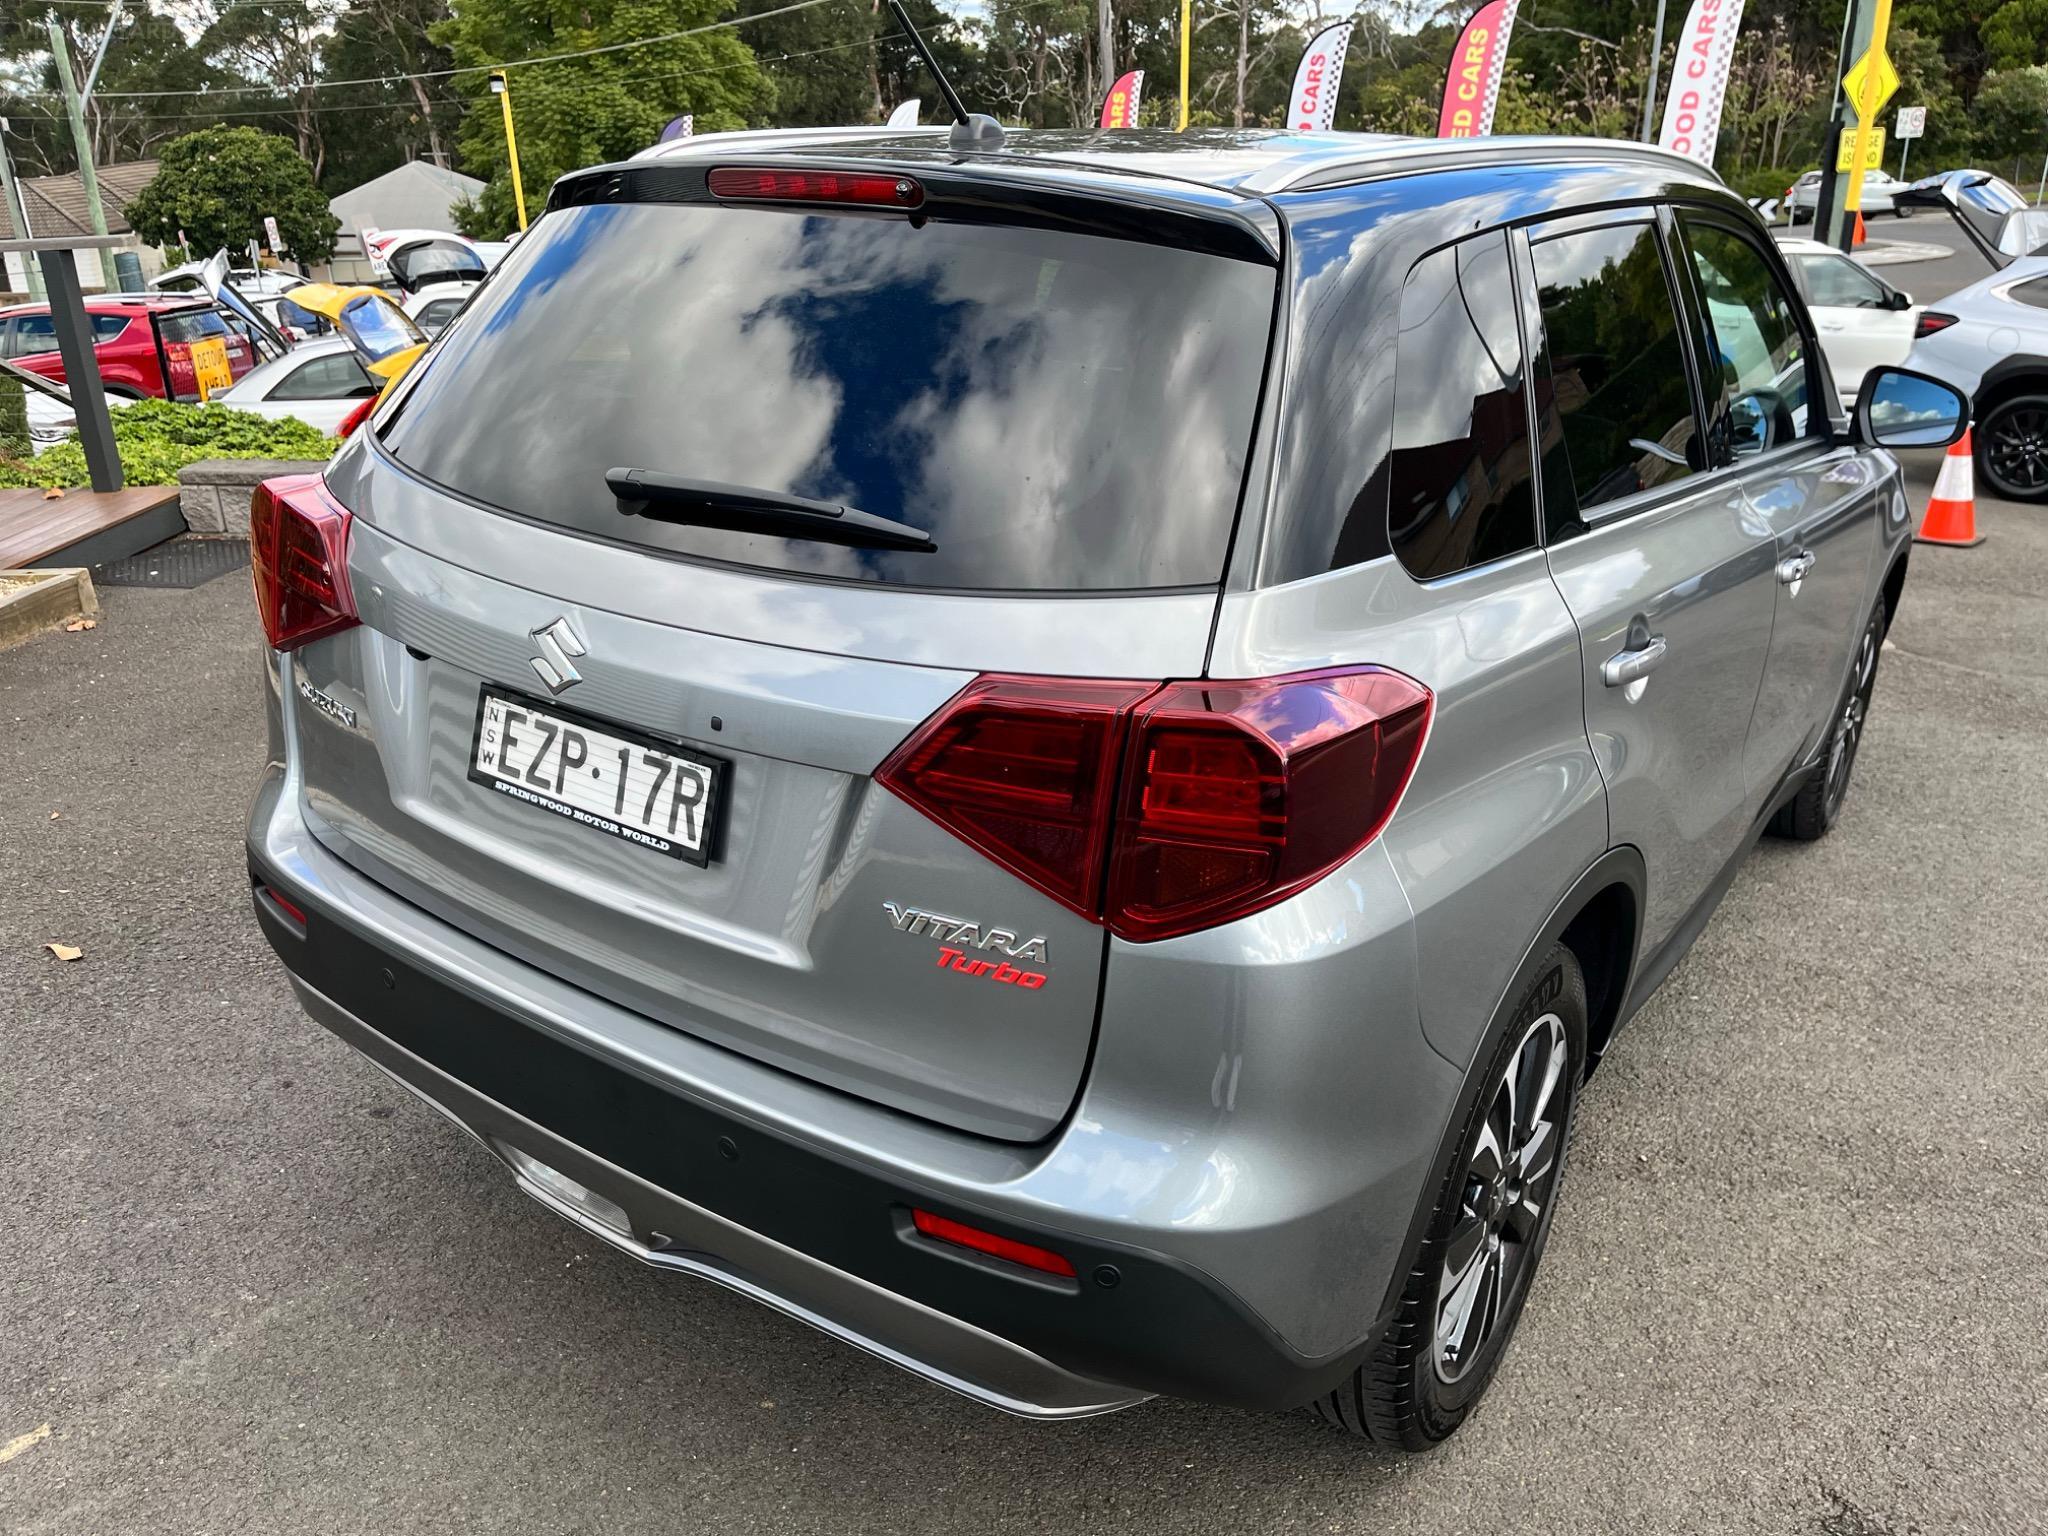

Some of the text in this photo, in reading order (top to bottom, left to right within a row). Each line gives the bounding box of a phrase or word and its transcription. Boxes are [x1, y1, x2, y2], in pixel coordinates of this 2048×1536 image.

[1301, 53, 1327, 114] CARS
[1450, 28, 1489, 138] ED CARS
[1671, 0, 1722, 155] OOD CARS
[1109, 91, 1126, 128] ARS
[1842, 150, 1878, 165] ISND
[1844, 134, 1881, 148] REGE
[196, 347, 224, 370] DETOUR
[494, 780, 671, 852] SPRINGWOOD MOTOR WORLD
[882, 901, 1048, 964] VITARA
[936, 946, 1048, 990] Turbo
